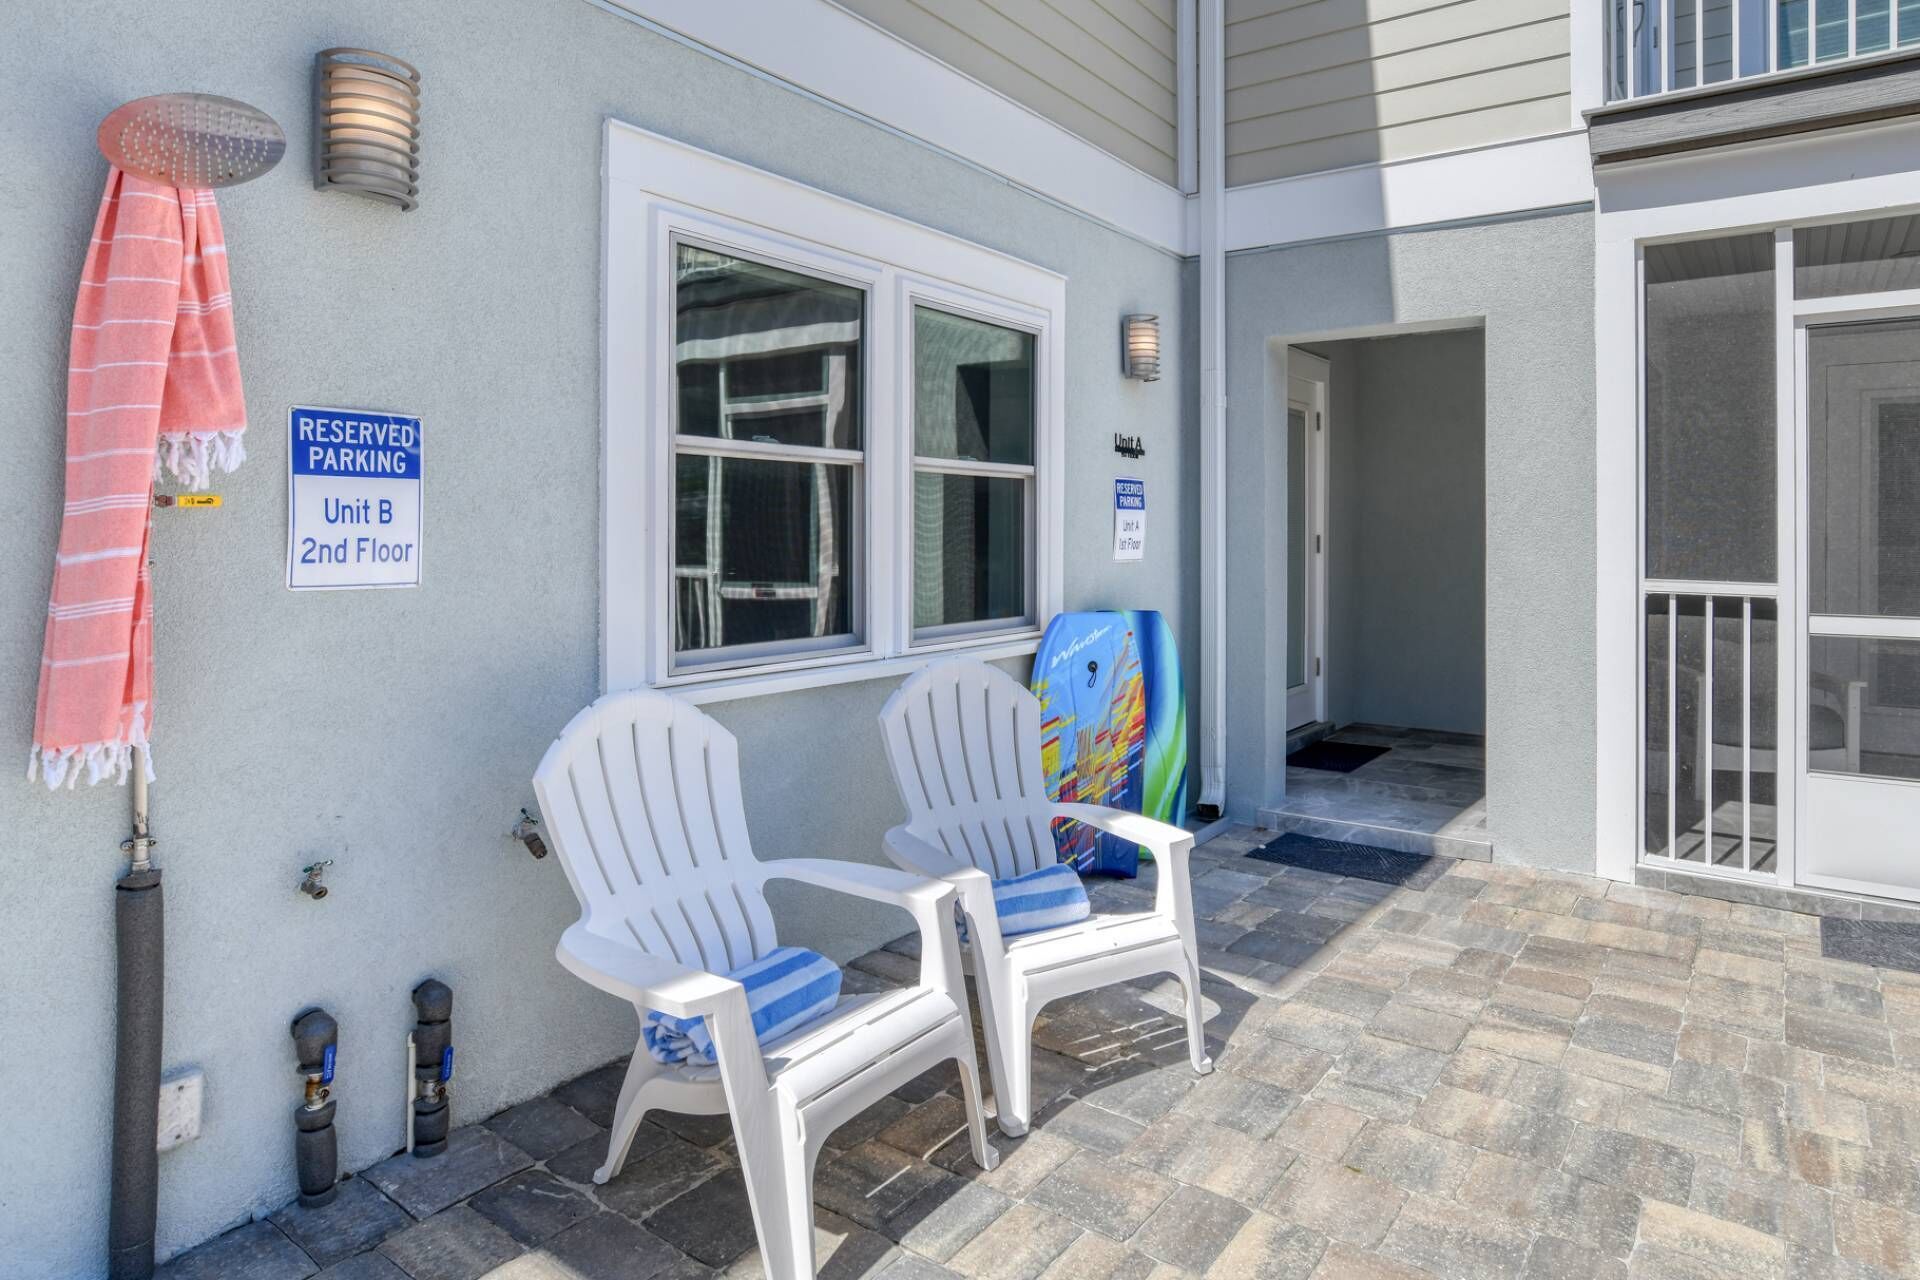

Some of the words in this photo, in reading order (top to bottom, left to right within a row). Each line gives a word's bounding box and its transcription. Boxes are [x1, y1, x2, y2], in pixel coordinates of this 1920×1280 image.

[299, 417, 415, 447] RESERVED
[309, 446, 407, 474] PARKING
[1116, 482, 1143, 495] RESERVED
[1119, 495, 1142, 508] PARKING
[324, 497, 370, 524] Unit
[379, 499, 393, 524] B
[300, 537, 347, 564] 2nd
[356, 537, 413, 563] Floor
